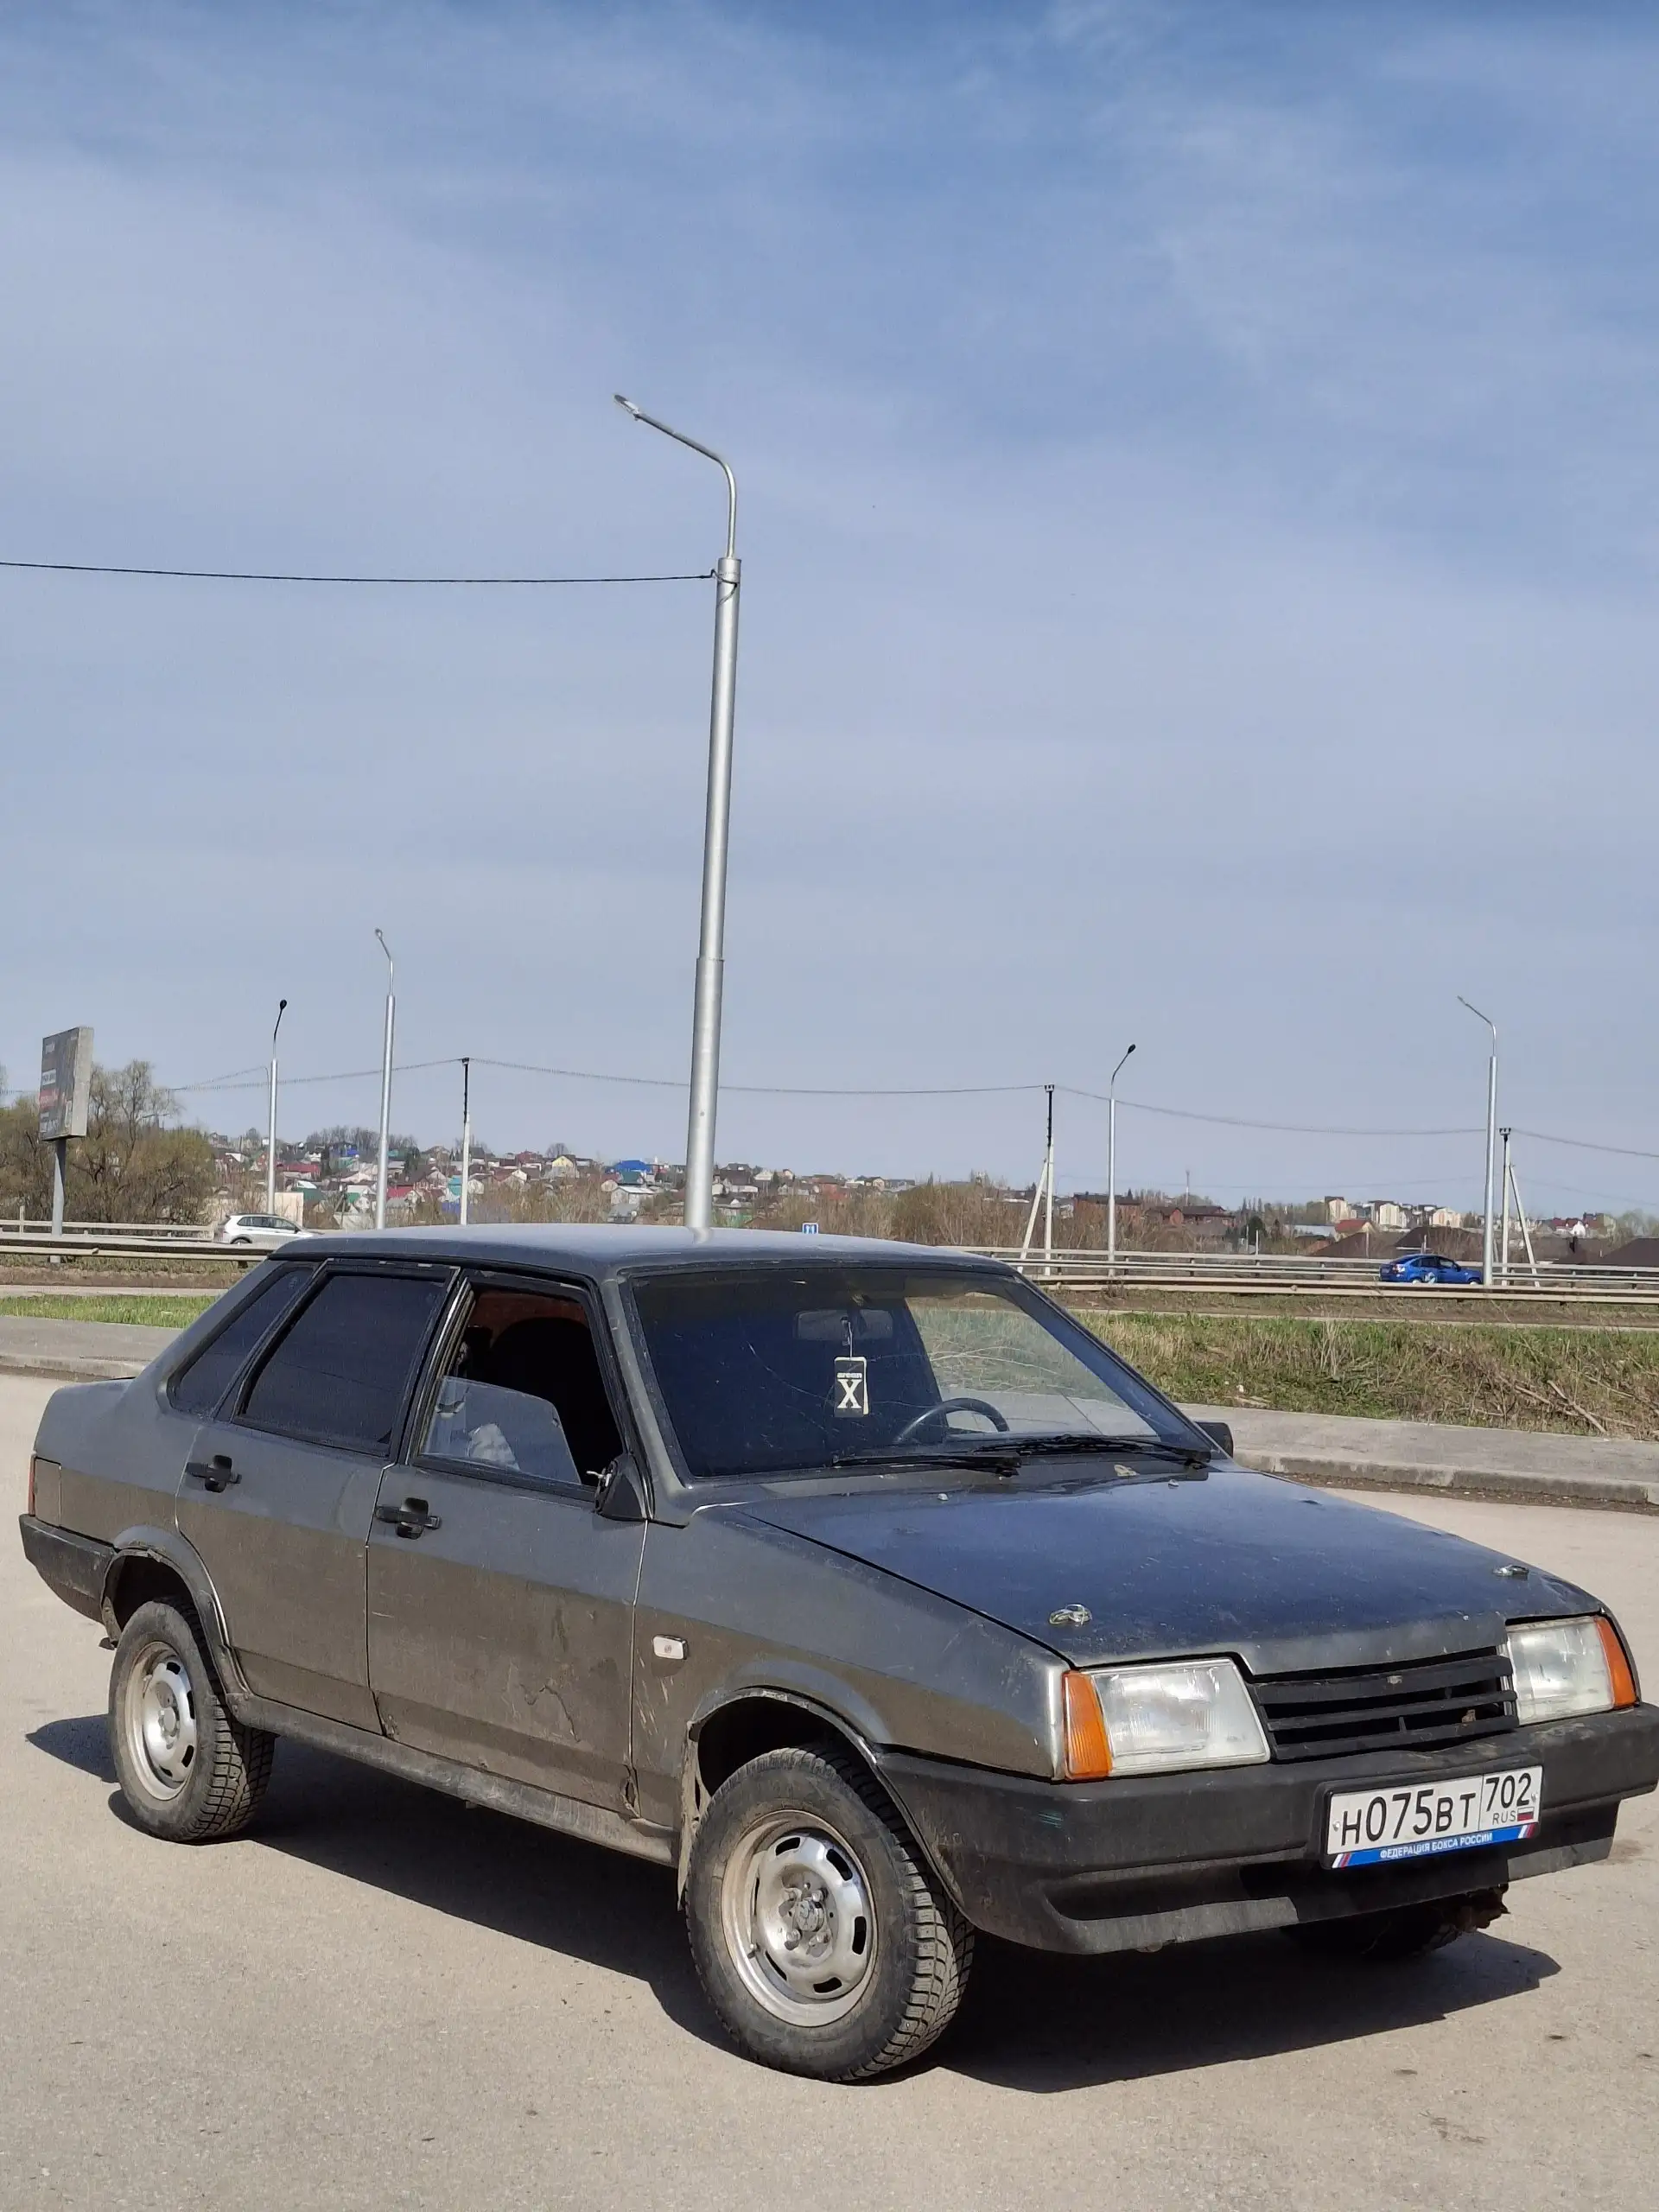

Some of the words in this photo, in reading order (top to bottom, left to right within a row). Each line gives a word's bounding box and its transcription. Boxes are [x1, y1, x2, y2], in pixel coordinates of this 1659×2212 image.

[836, 1379, 862, 1408] X
[1340, 1789, 1477, 1847] Н075ВТ
[1485, 1772, 1532, 1812] 702
[1491, 1809, 1516, 1826] RUS
[1380, 1842, 1430, 1859] ФЕДЕРАЦИЯ
[1431, 1837, 1459, 1852] БОКСА
[1459, 1832, 1493, 1847] РОССИИ
